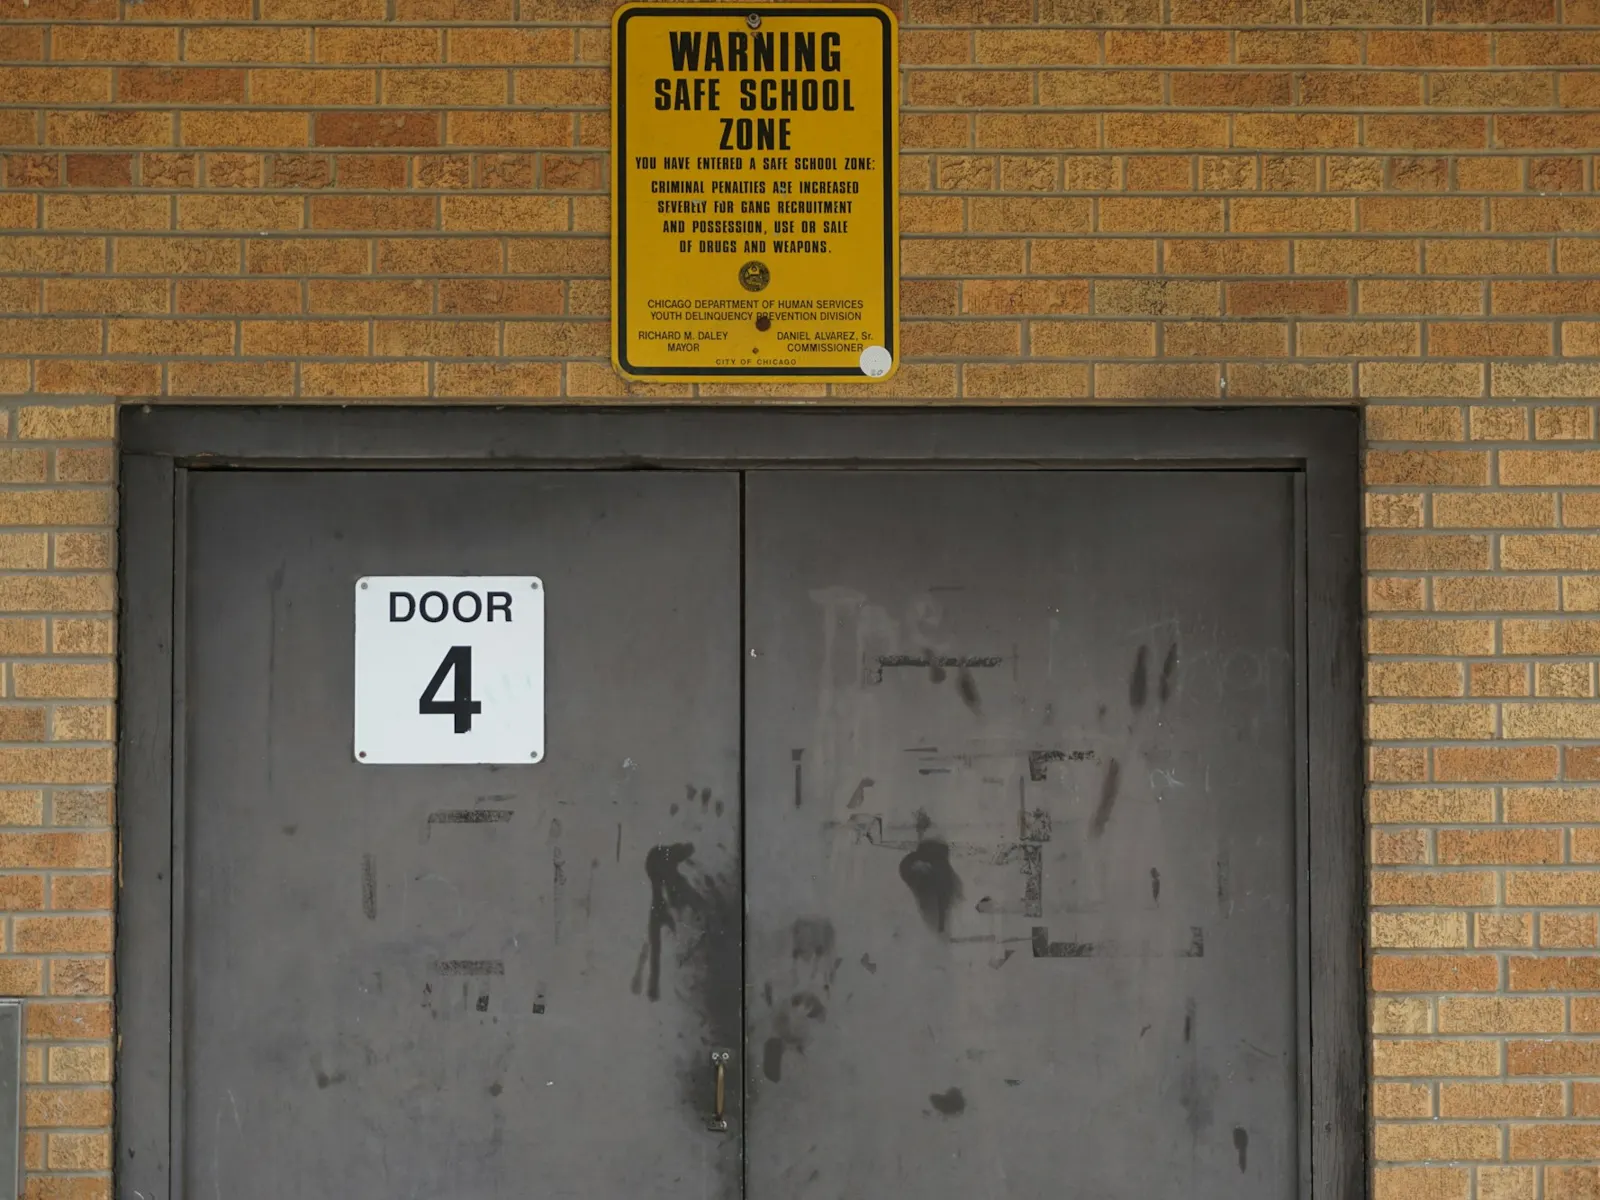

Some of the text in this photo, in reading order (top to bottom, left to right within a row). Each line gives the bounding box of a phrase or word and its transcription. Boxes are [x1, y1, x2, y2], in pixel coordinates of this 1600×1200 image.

[669, 31, 841, 72] WARNING
[654, 78, 855, 111] SAFE SCHOOL
[719, 118, 792, 150] ZONE
[635, 157, 876, 170] YOU HAVE ENTERED A SAFE SCHOOL ZONE:
[651, 181, 859, 194] CRIMINAL PENALTIES ARE INCREASED
[657, 200, 853, 214] SEVERELY FOR GANG RECRUITMENT
[663, 220, 848, 235] AND POSSESSION, USE OR SALE
[679, 240, 832, 253] OF DRUGS AND WEAPONS.
[647, 299, 864, 309] CHICAGO DEPARTMENT OF HUMAN SERVICES
[650, 311, 682, 321] YOUTH
[685, 311, 753, 321] DELINQUENCY
[820, 311, 862, 321] DIVISION
[638, 330, 728, 340] RICHARD M. DALEY
[776, 331, 874, 341] DANIEL ALVAREZ, Sr.
[667, 342, 700, 352] MAYOR
[787, 343, 864, 352] COMMISSIONER
[756, 358, 797, 366] CHICAGO
[389, 590, 513, 623] DOOR
[418, 645, 482, 734] 4
